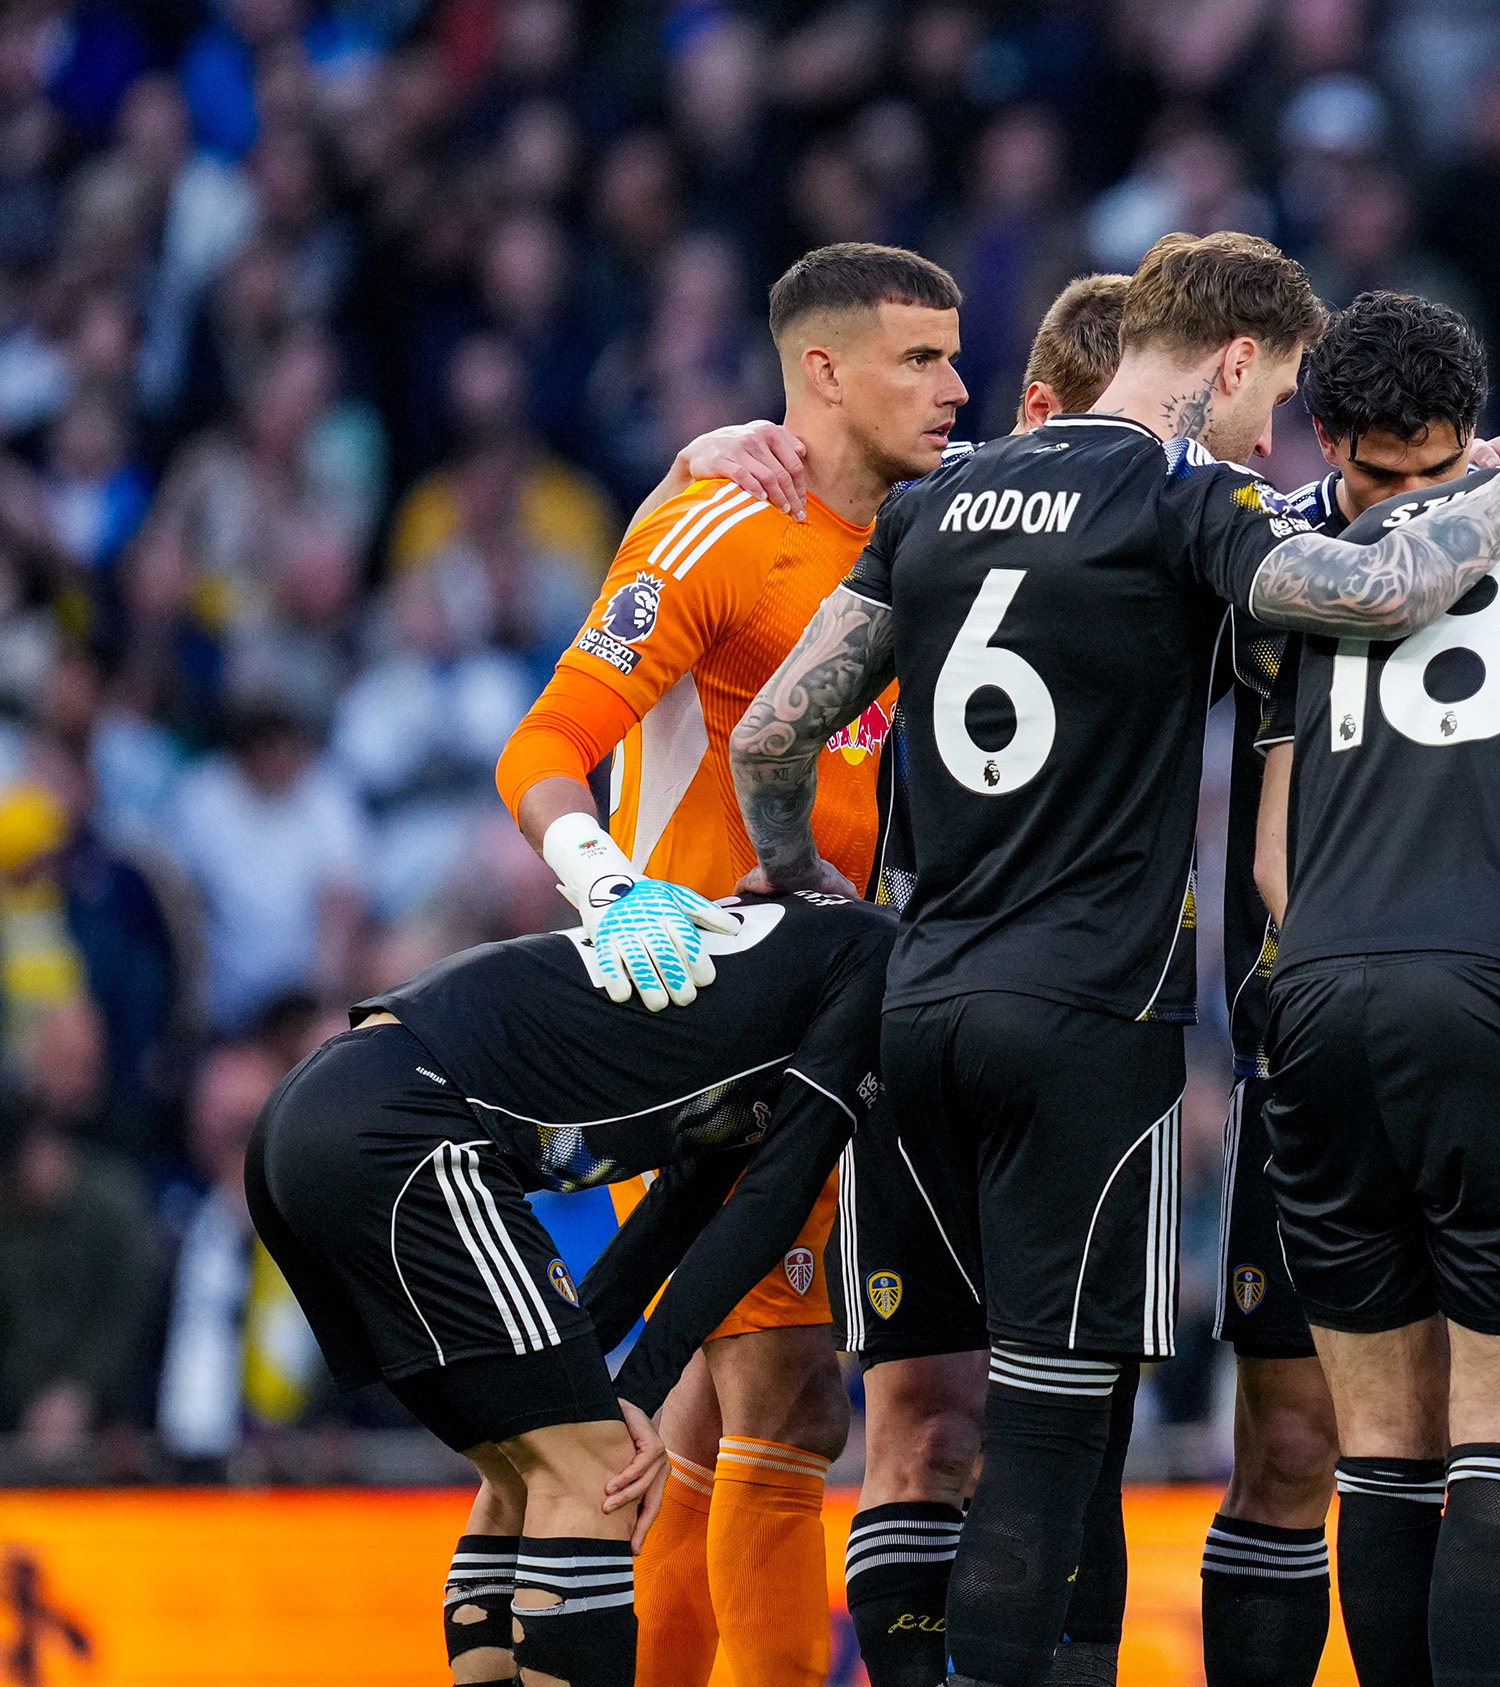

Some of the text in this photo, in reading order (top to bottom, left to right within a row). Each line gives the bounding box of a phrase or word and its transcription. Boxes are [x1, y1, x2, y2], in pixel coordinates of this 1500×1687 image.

[938, 489, 1081, 534] RODON
[582, 627, 635, 662] No room
[590, 644, 633, 676] racism
[934, 568, 1057, 795] 6
